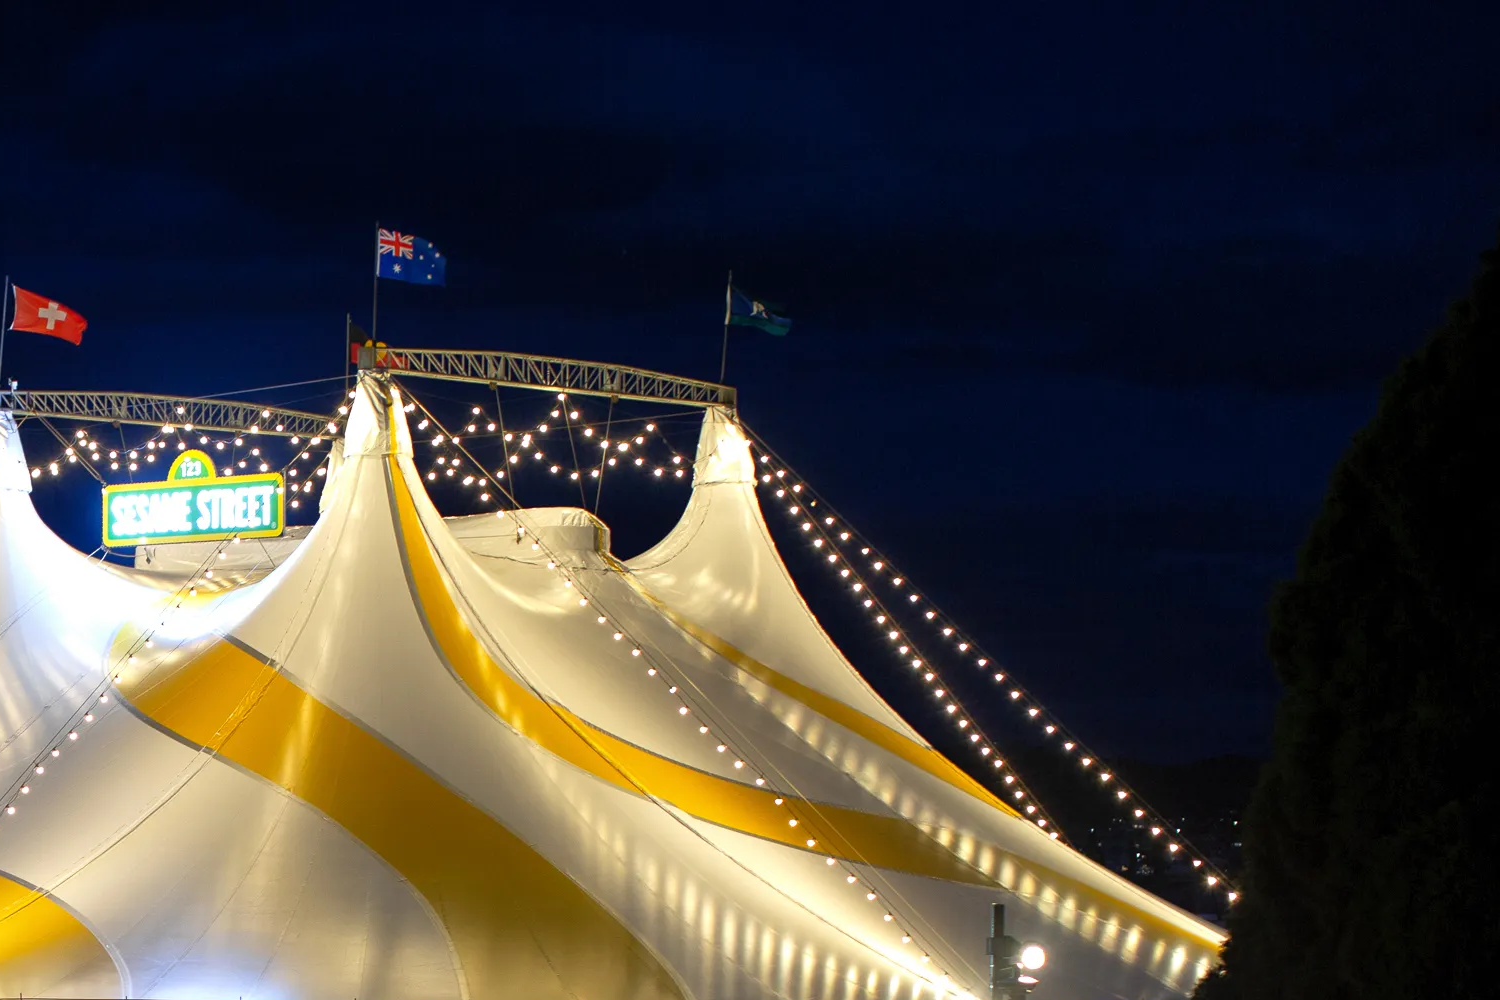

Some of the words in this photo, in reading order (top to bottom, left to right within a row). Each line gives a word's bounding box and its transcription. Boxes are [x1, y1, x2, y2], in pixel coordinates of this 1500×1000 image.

[179, 460, 202, 478] 123
[110, 490, 193, 537] SESAME
[197, 485, 275, 530] STREET
